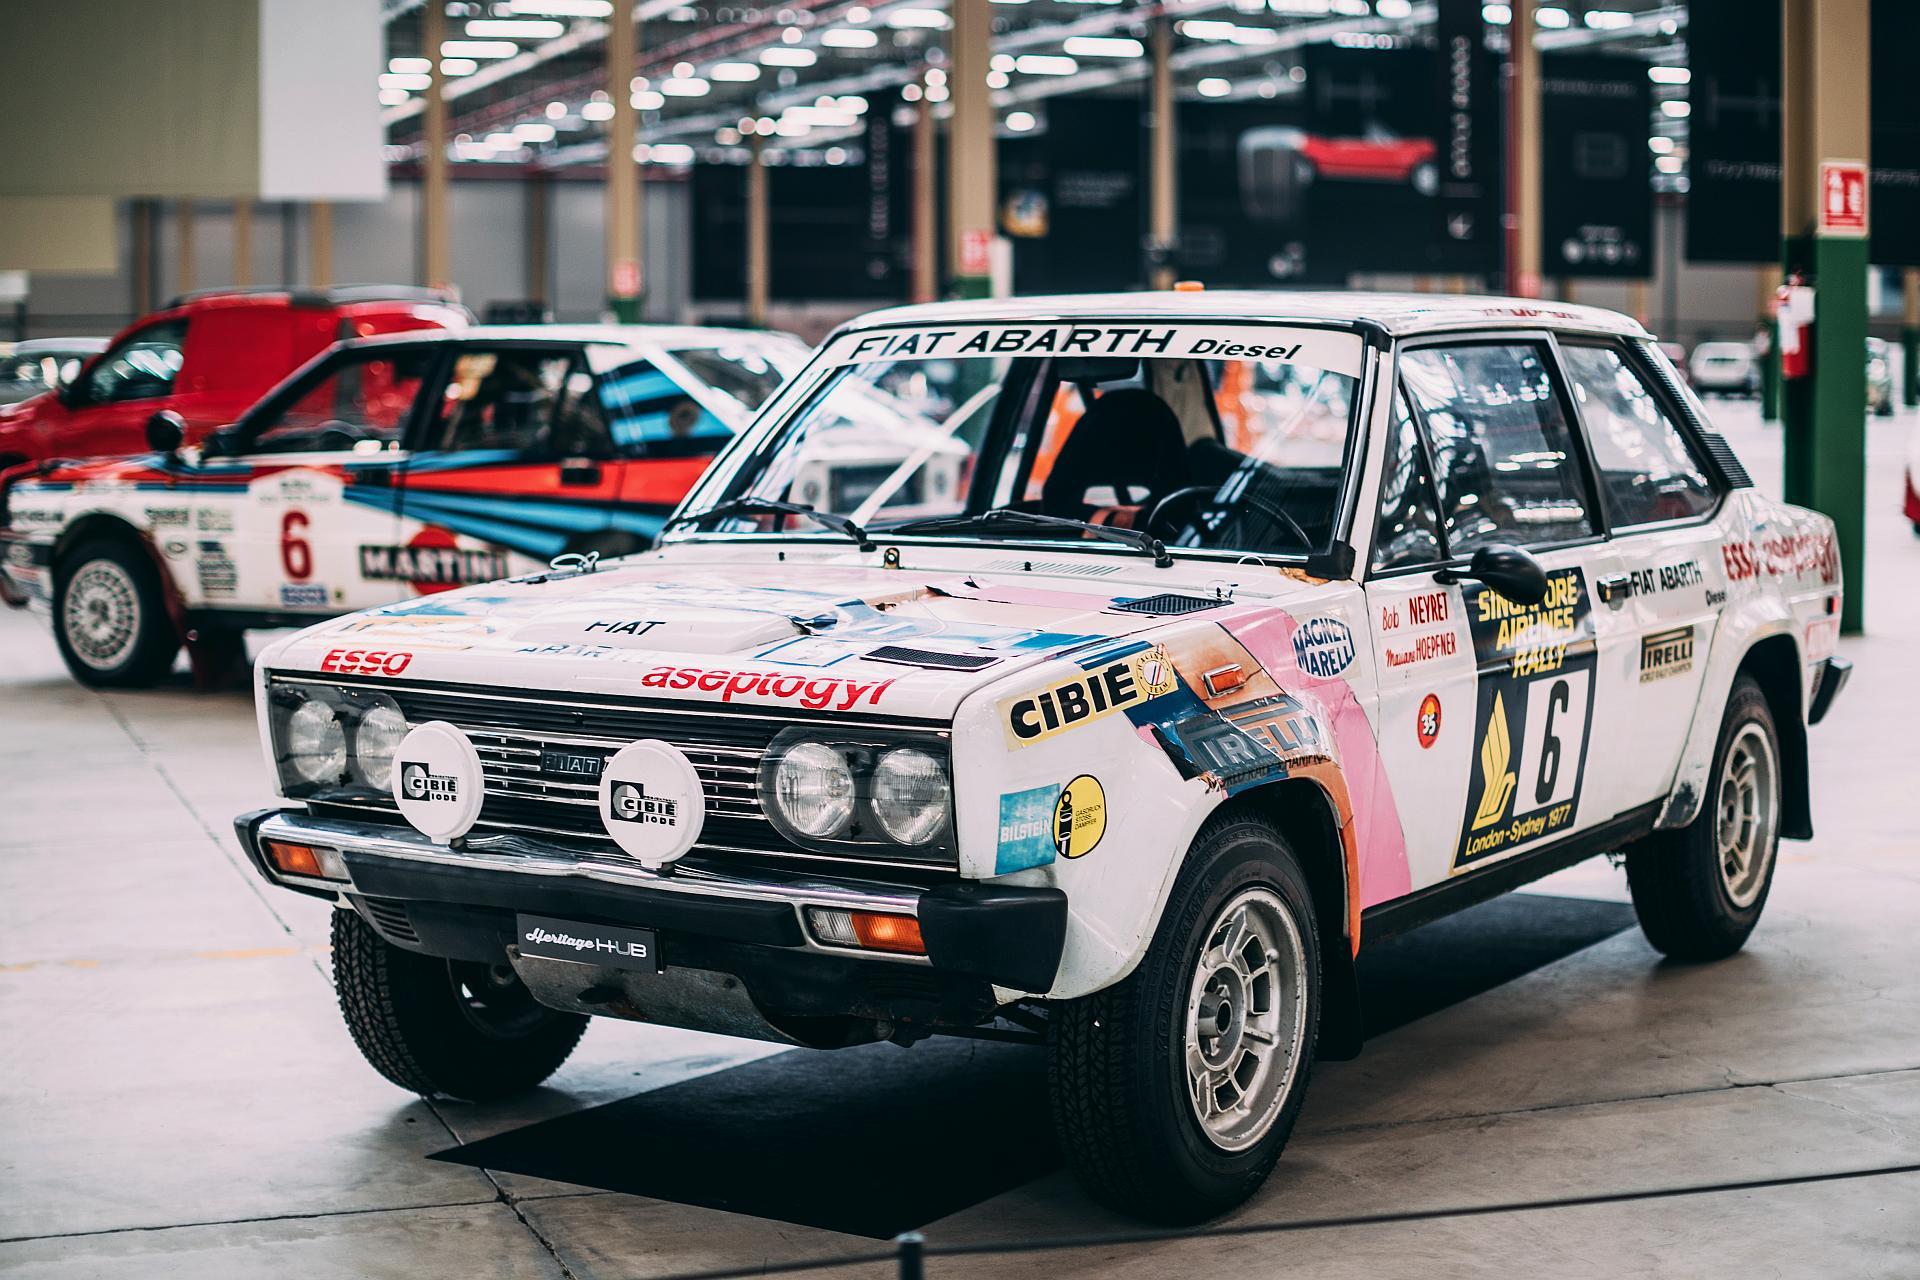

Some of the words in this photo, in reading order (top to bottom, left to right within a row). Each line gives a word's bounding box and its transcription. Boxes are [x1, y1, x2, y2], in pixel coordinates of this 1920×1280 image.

[849, 332, 956, 360] FIAT
[959, 328, 1178, 353] ABARTH
[1188, 338, 1303, 359] Diesel
[281, 511, 313, 579] 6
[364, 547, 508, 581] MARTINI
[1631, 568, 1656, 596] FIAT
[1660, 560, 1703, 593] ABARTH
[1382, 606, 1400, 631] Bob
[1409, 592, 1449, 625] NEYRET
[1478, 573, 1578, 622] SINORE
[1496, 606, 1575, 651] AIRLINES
[320, 649, 413, 676] ESSO
[1415, 632, 1457, 662] HOEPFNER
[1512, 642, 1567, 678] RALLY
[1641, 625, 1694, 671] PIRELLI
[641, 666, 897, 711] aseptogyl
[1421, 712, 1438, 736] 35
[1535, 680, 1569, 805] 6
[545, 756, 597, 772] FIAT
[431, 793, 456, 802] IODE
[645, 815, 675, 827] IODE
[1000, 819, 1051, 843] BILSTEIN
[1548, 804, 1572, 828] 1977
[525, 927, 595, 951] Heritage
[596, 938, 647, 958] HUB
